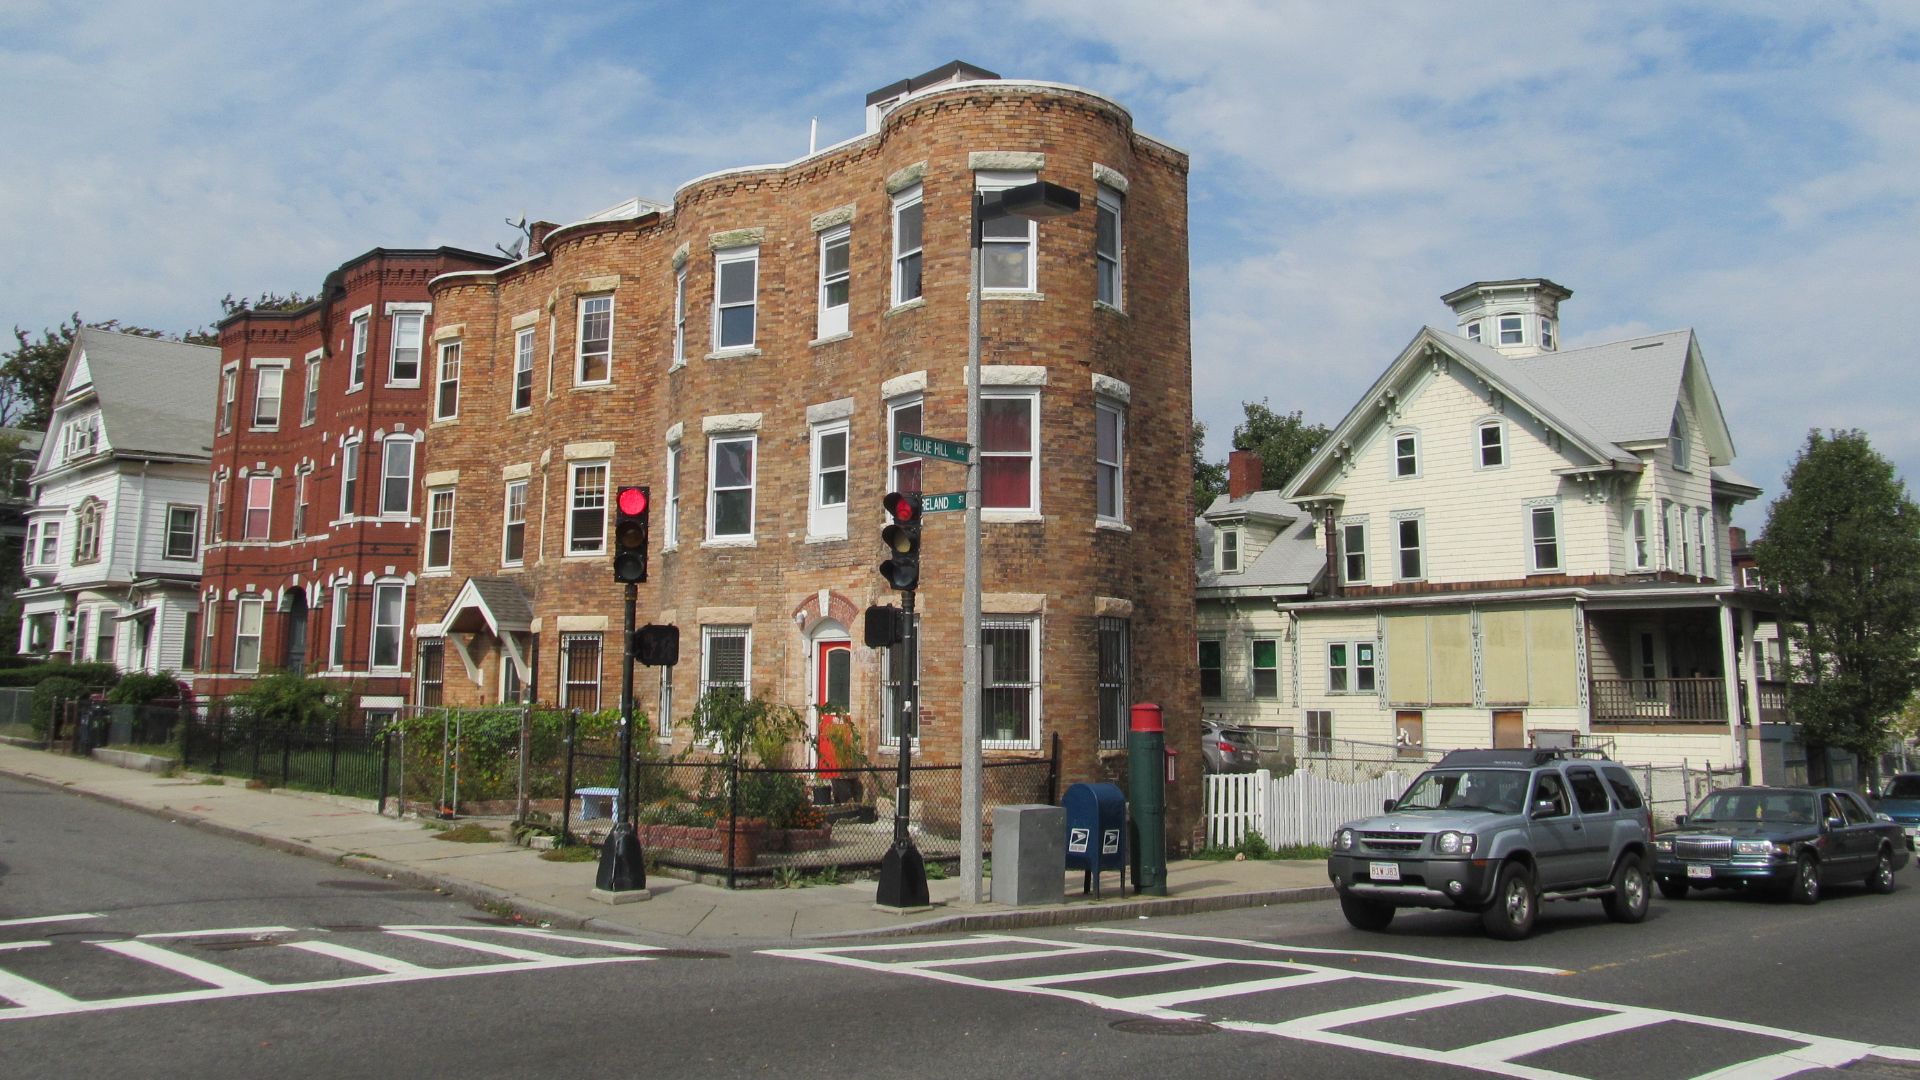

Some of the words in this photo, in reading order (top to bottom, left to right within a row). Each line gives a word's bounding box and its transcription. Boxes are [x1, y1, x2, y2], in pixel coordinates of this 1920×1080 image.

[914, 439, 931, 454] BLUE
[934, 442, 949, 457] HILL
[956, 447, 964, 455] AVE
[958, 495, 964, 503] ST
